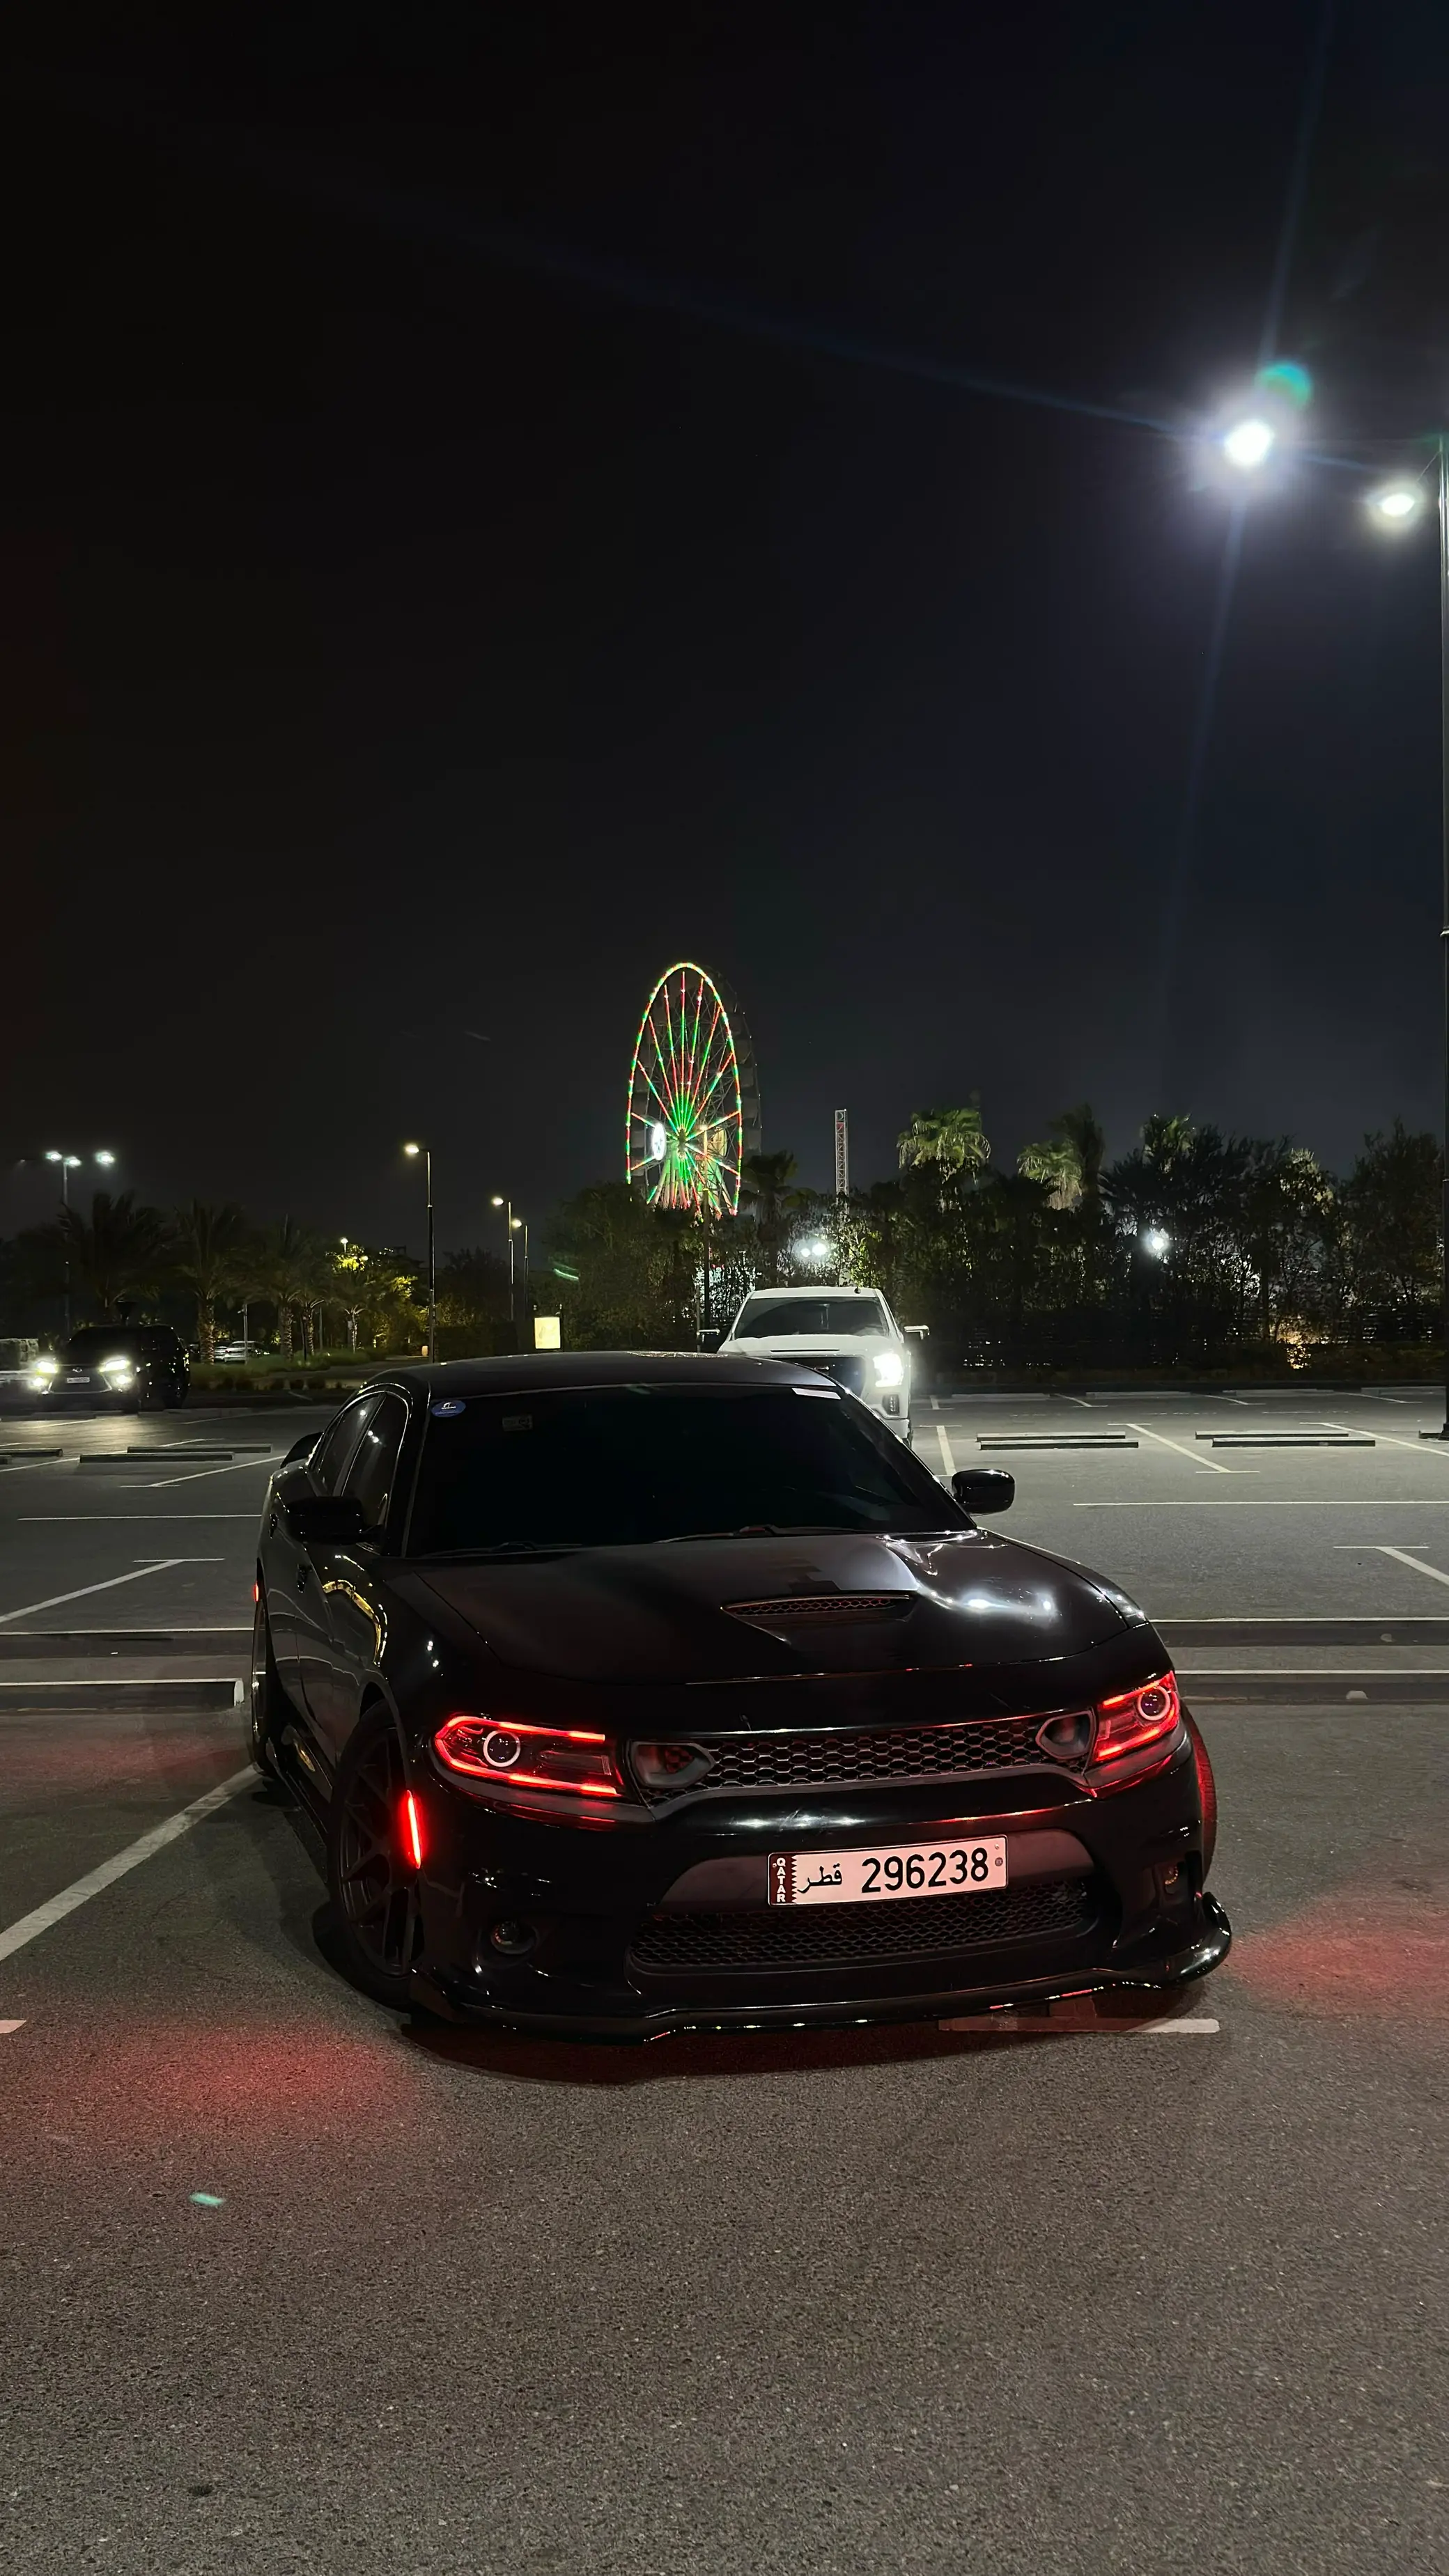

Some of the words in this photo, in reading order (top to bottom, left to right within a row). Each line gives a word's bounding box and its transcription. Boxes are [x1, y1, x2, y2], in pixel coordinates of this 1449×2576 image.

[776, 1857, 787, 1903] QATAR
[796, 1862, 843, 1894] قطر
[861, 1847, 989, 1894] 296238
